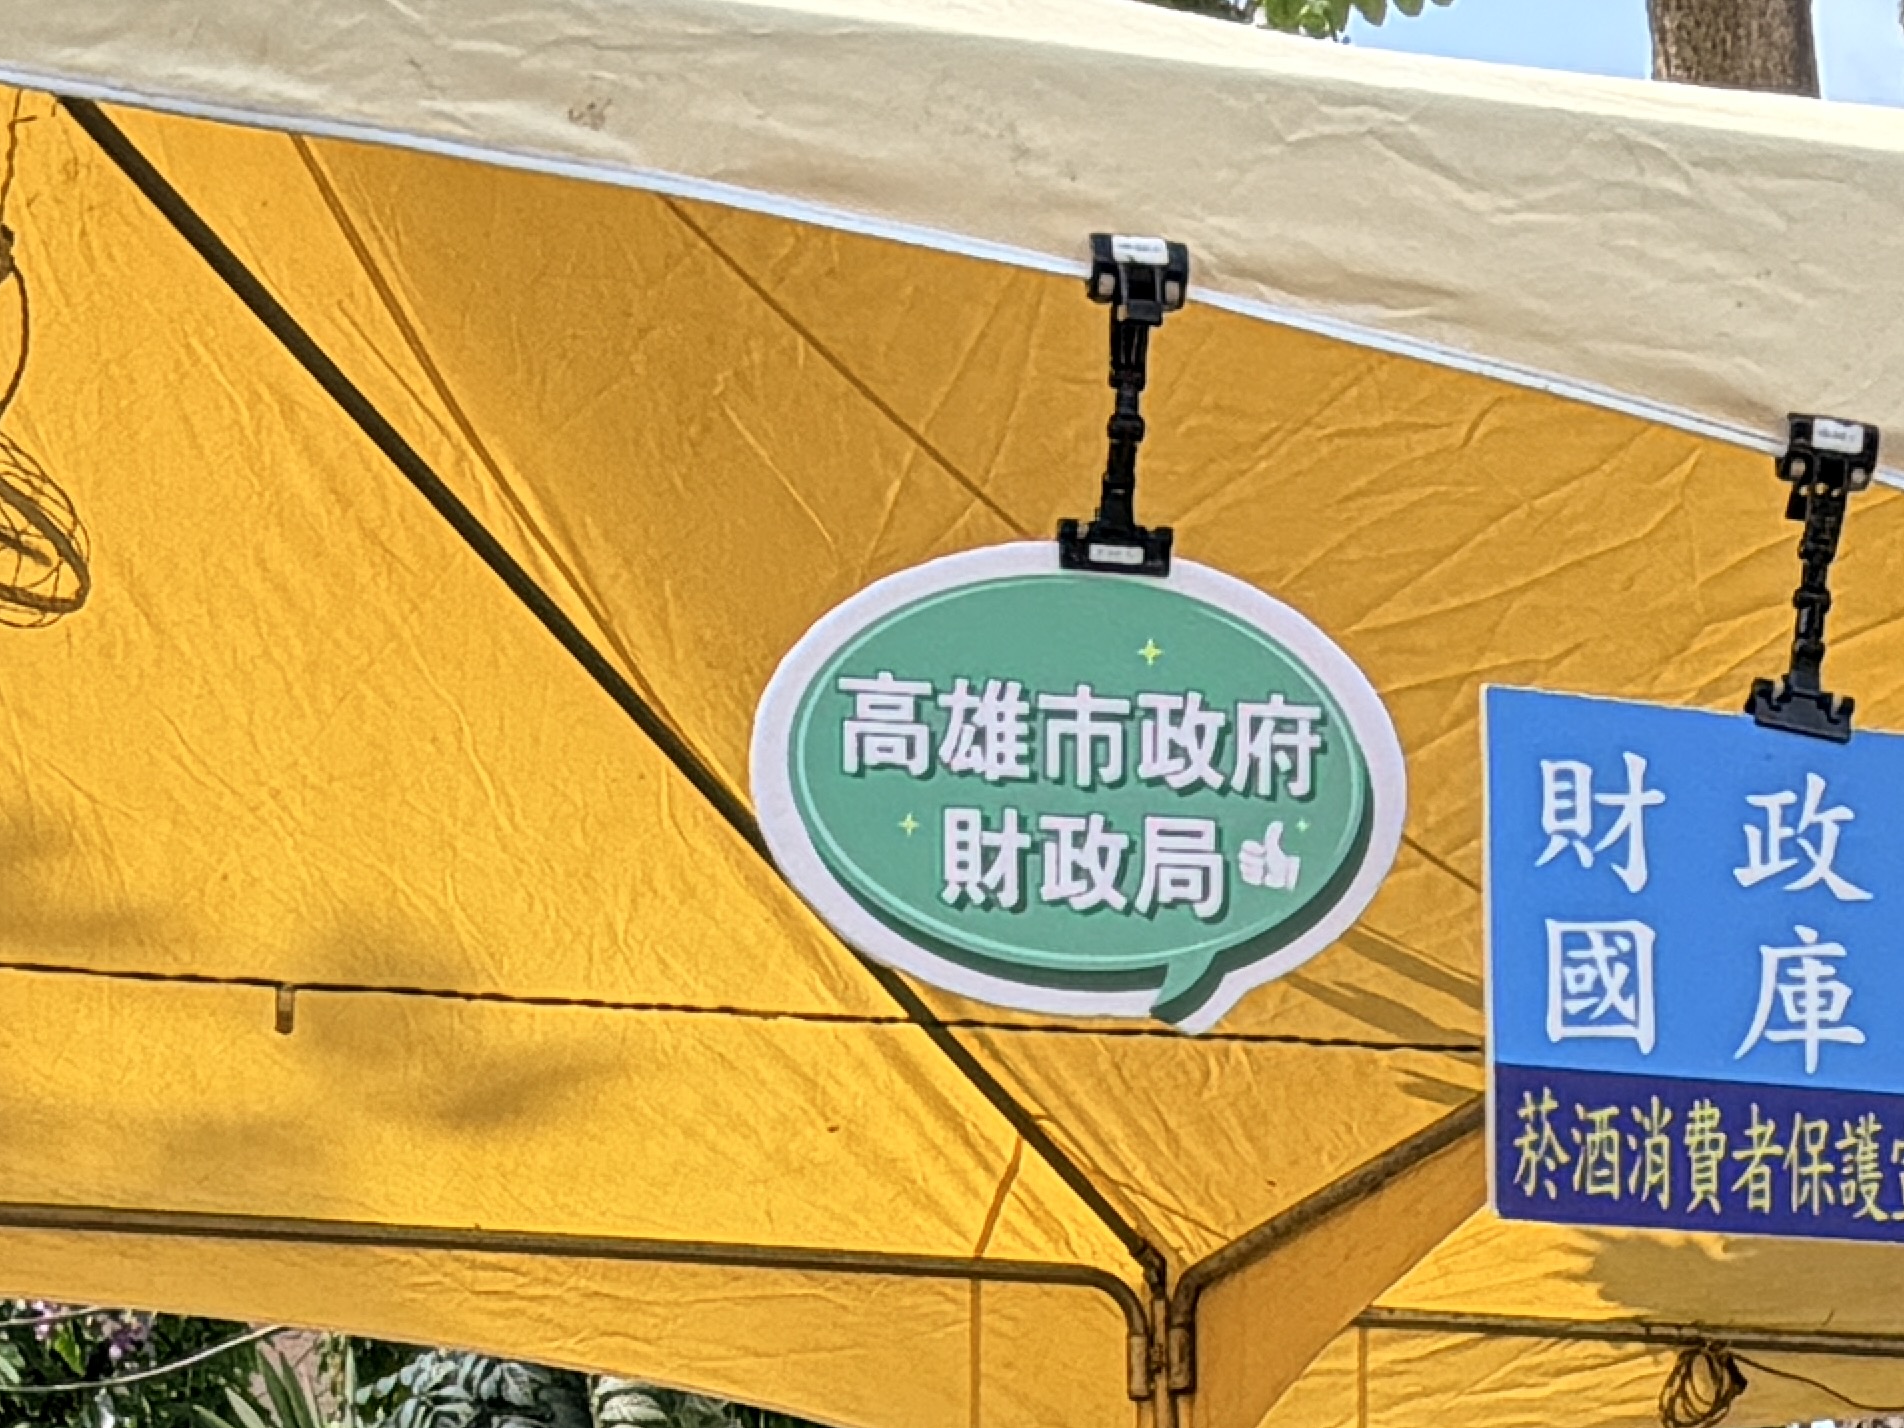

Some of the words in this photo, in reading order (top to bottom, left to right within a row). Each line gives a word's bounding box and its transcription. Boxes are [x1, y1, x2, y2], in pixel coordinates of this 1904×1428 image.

[837, 671, 1324, 798] 高雄市政府
[941, 806, 1228, 920] 財政局
